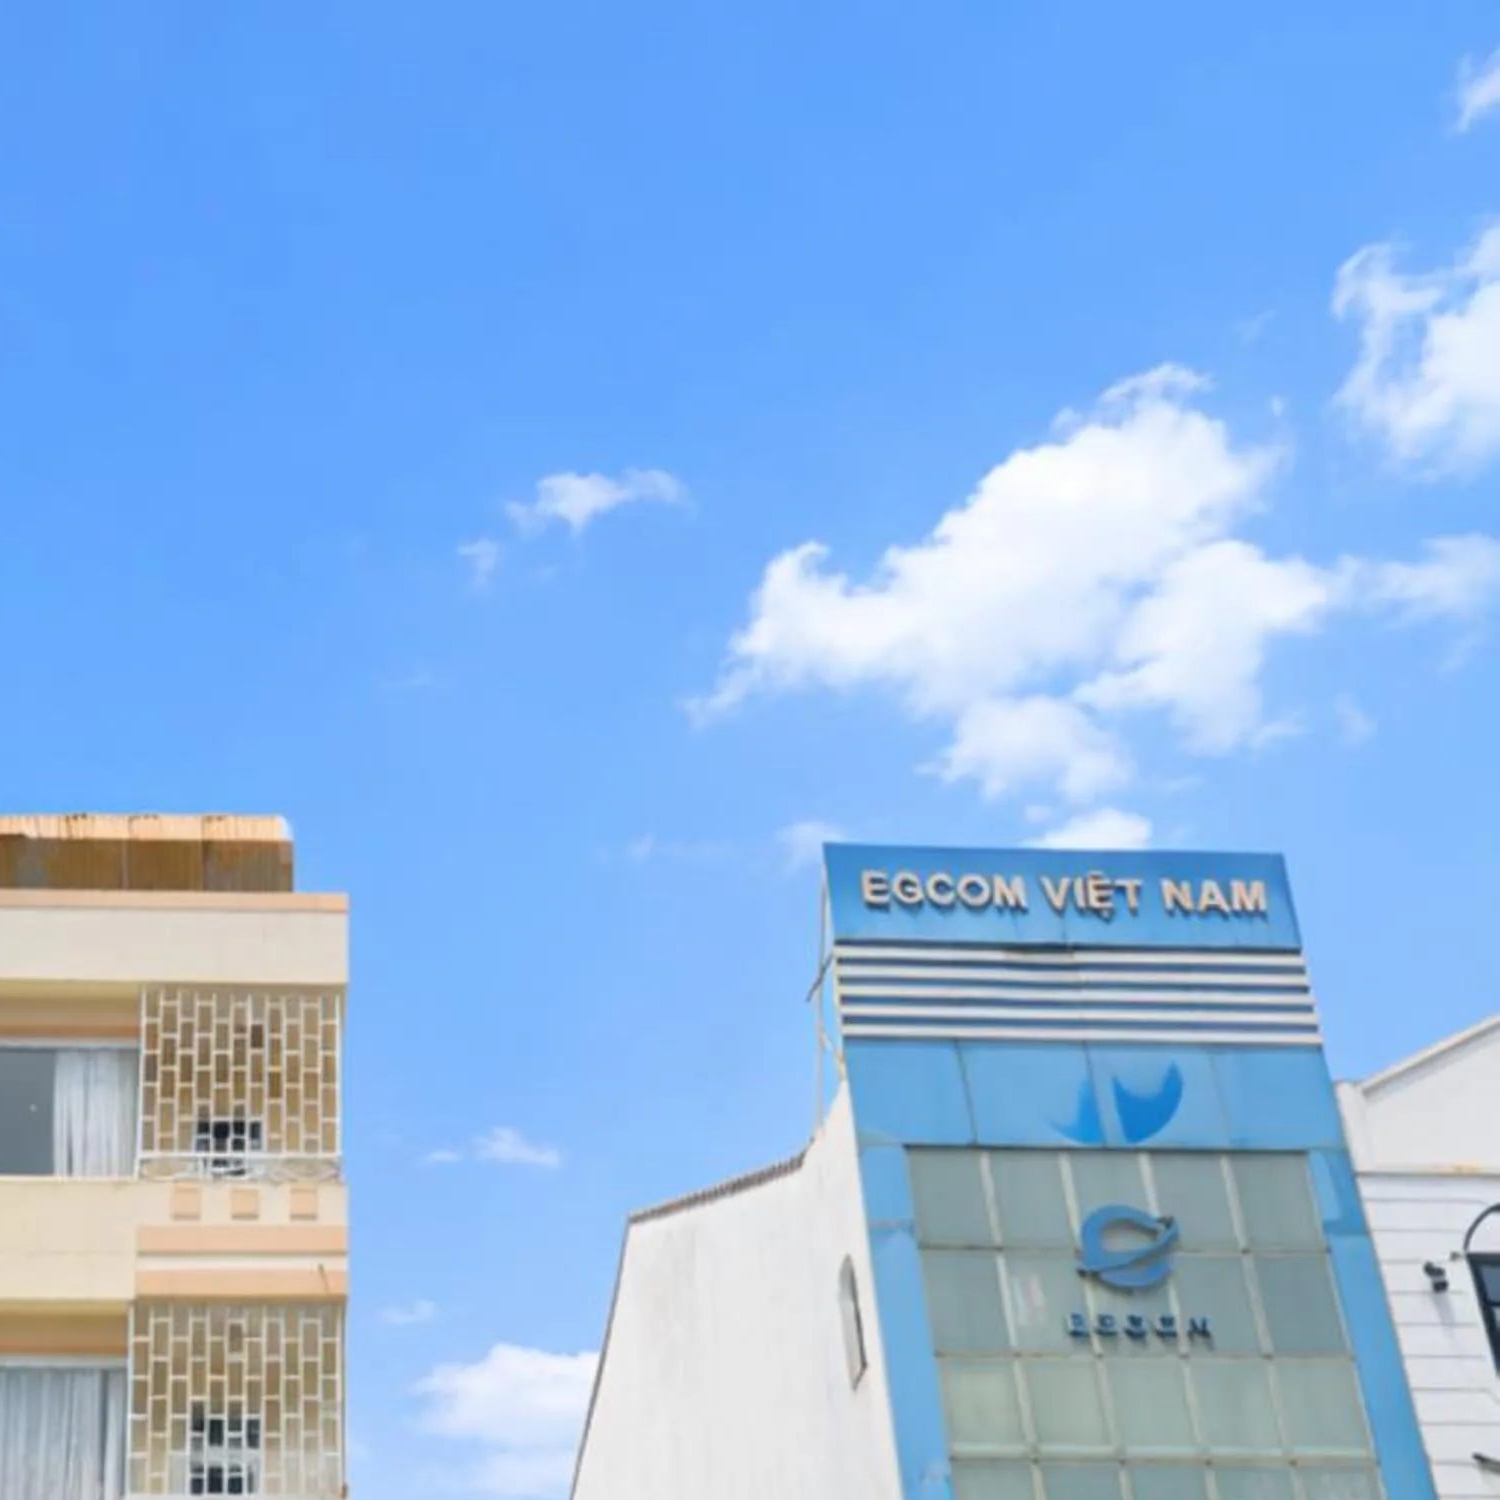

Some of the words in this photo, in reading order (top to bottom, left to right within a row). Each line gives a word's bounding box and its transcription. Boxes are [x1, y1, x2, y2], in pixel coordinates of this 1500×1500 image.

[861, 869, 1028, 909] EGCOM
[1041, 870, 1143, 920] VIỆT
[1161, 878, 1269, 913] NAM
